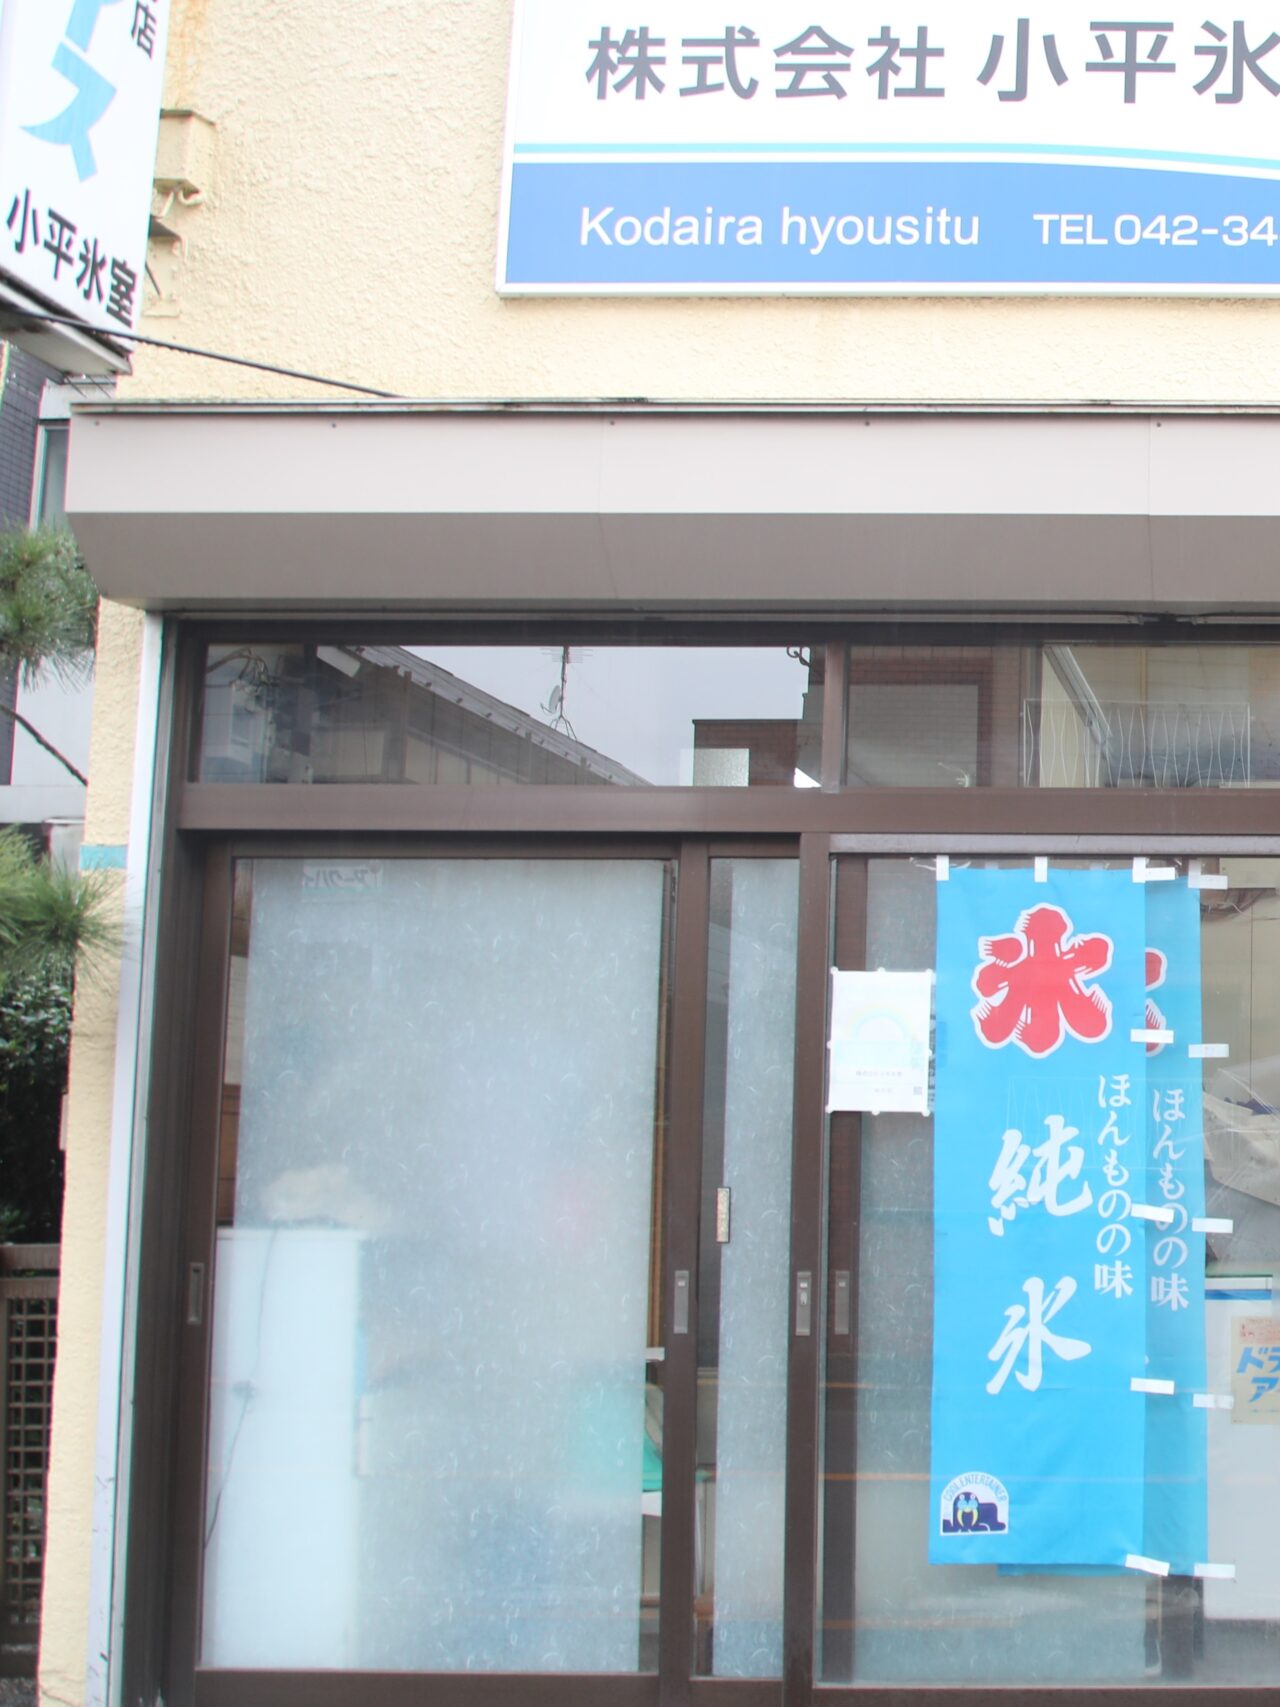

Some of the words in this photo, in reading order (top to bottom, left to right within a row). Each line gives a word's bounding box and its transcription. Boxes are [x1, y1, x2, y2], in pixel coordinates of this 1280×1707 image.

[585, 25, 946, 101] 株式会社
[6, 187, 138, 329] 小平氷室
[579, 206, 763, 247] Kodaira
[780, 206, 981, 256] hyousitu
[970, 901, 1115, 1059] 氷
[1094, 1073, 1134, 1299] ほんものの味
[1151, 1089, 1190, 1312] ほんものの味
